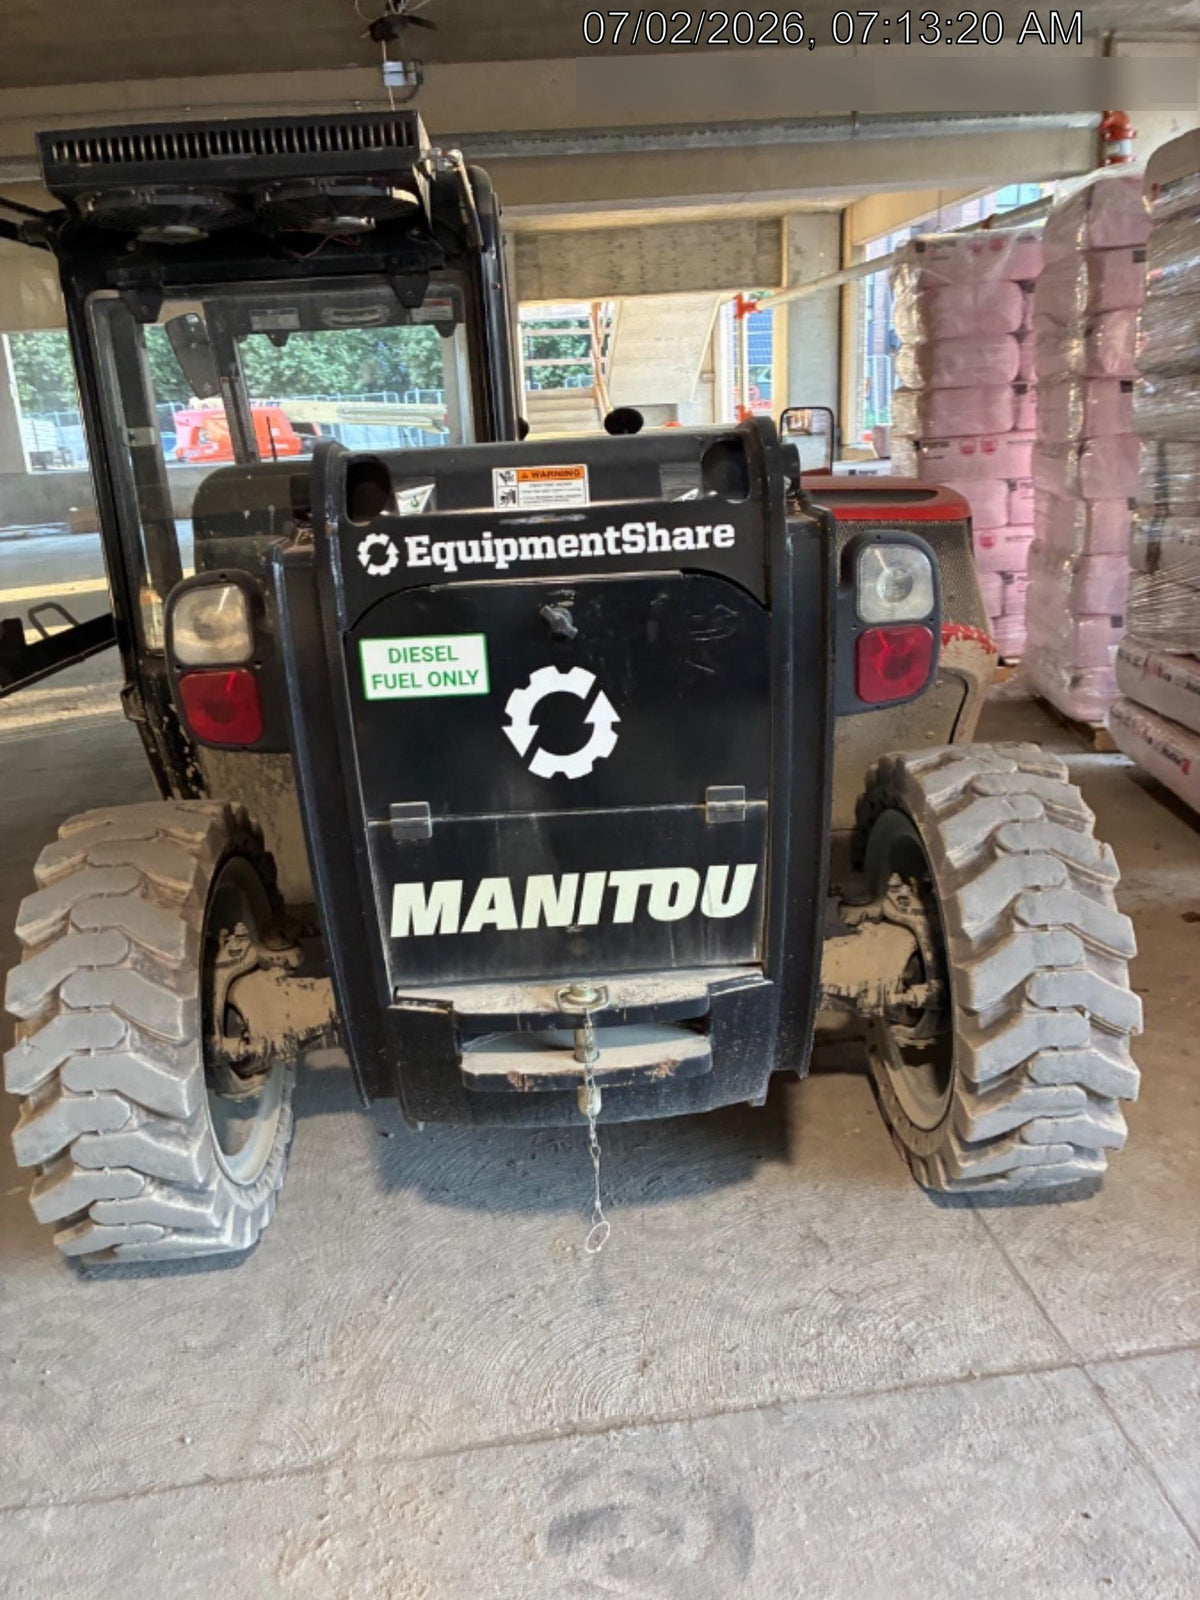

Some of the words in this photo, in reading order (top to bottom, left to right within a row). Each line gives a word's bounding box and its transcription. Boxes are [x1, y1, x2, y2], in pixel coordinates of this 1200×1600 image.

[531, 469, 581, 479] WARNING
[404, 522, 735, 573] EquipmentShare
[388, 645, 459, 664] DIESEL
[372, 672, 422, 690] FUEL
[427, 670, 479, 687] ONLY
[390, 863, 758, 938] MANITOU
